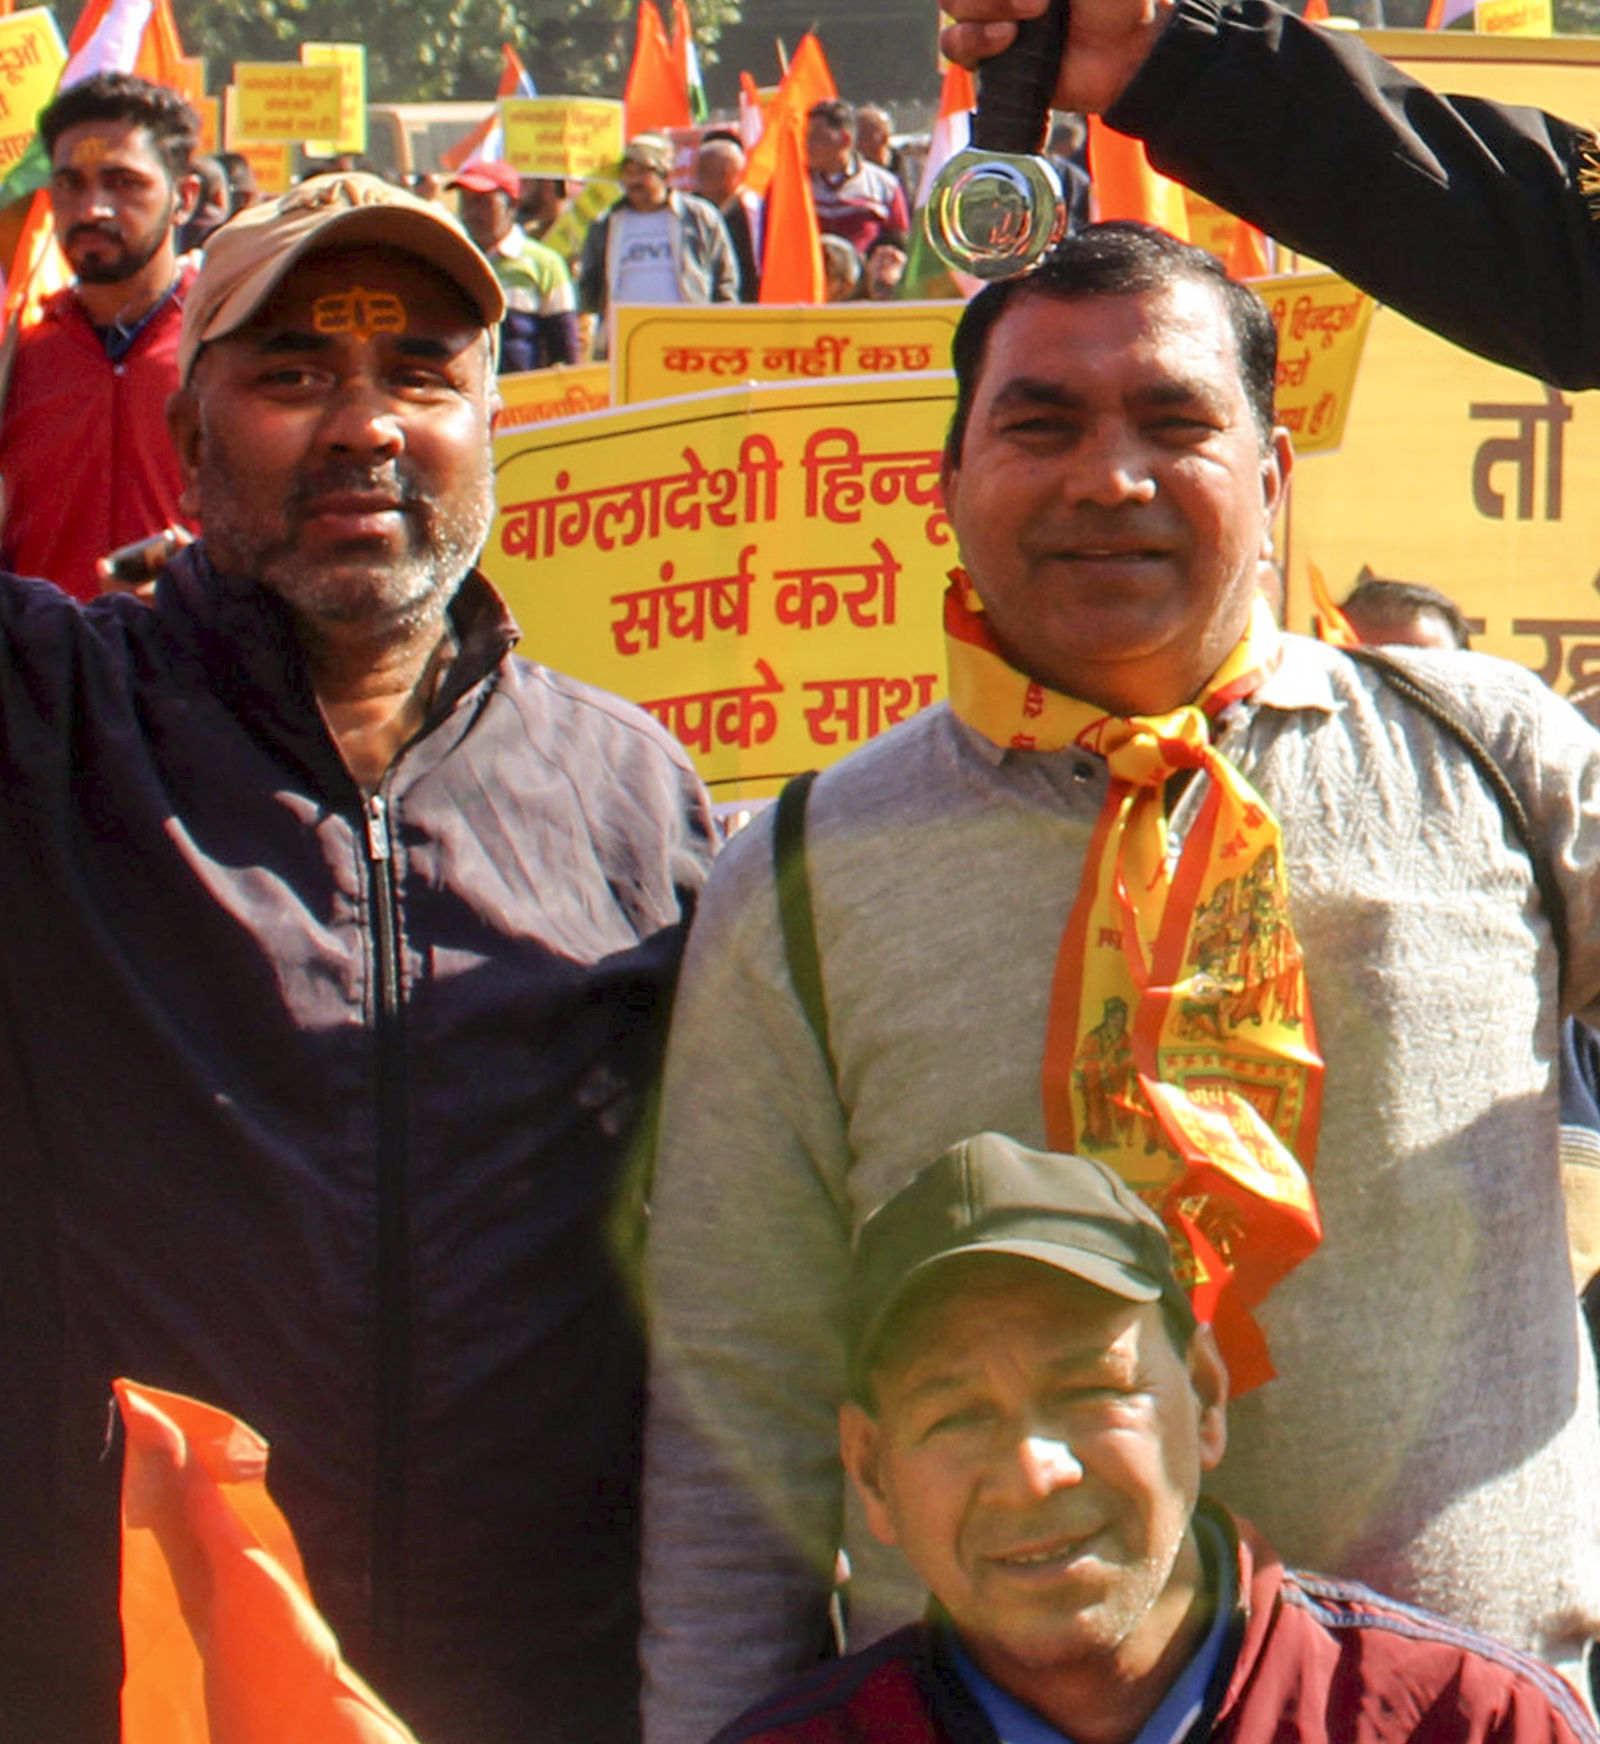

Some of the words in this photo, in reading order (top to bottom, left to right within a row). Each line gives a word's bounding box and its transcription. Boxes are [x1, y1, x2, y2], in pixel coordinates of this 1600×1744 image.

[661, 347, 752, 375] कल
[762, 335, 850, 376] नहीं
[857, 344, 933, 371] कछ
[500, 434, 784, 560] बांग्लादेशी
[1470, 385, 1572, 521] तो
[610, 545, 757, 656] संघर्ष
[775, 540, 901, 628] करो
